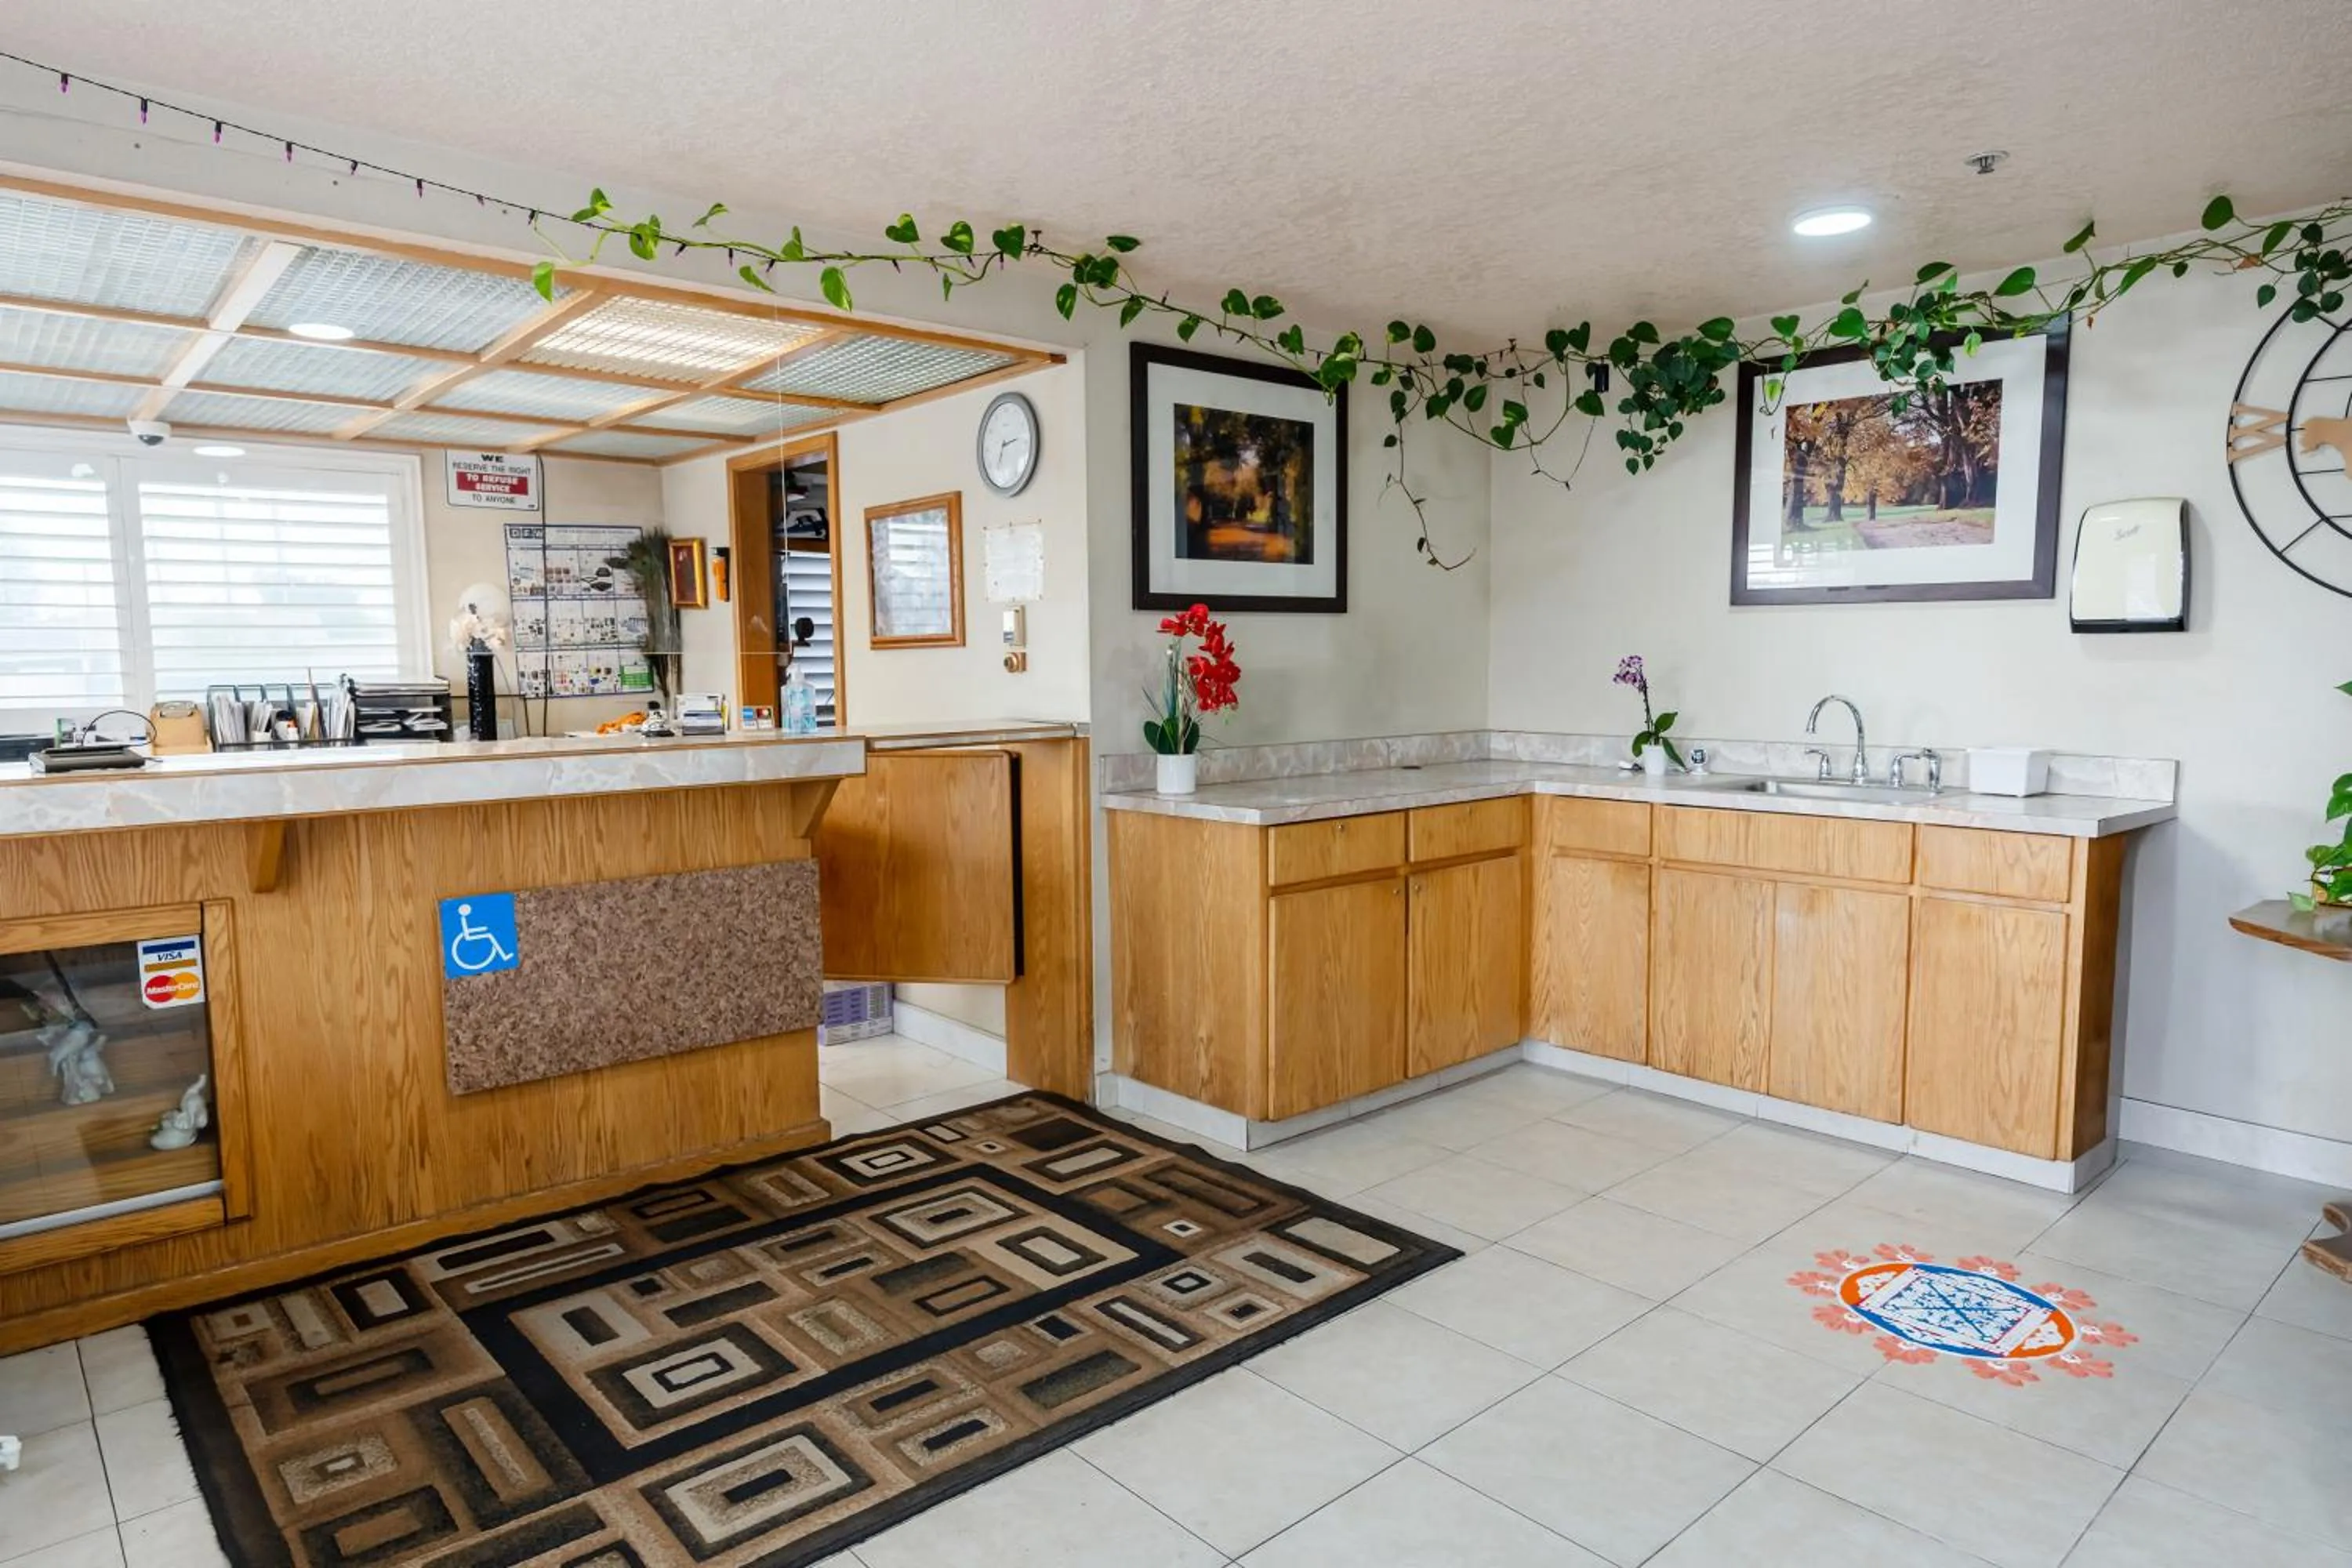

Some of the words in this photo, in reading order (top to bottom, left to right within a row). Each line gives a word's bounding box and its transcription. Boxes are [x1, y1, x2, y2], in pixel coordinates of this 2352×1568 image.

[481, 454, 504, 463] WE
[452, 462, 487, 472] RESERVE
[509, 466, 531, 475] RIGHT
[466, 473, 479, 481] TO
[483, 475, 518, 485] REFUSE
[475, 483, 510, 492] SERVICE
[472, 494, 482, 503] TO
[158, 951, 183, 961] VISA
[147, 982, 199, 994] MasterCard
